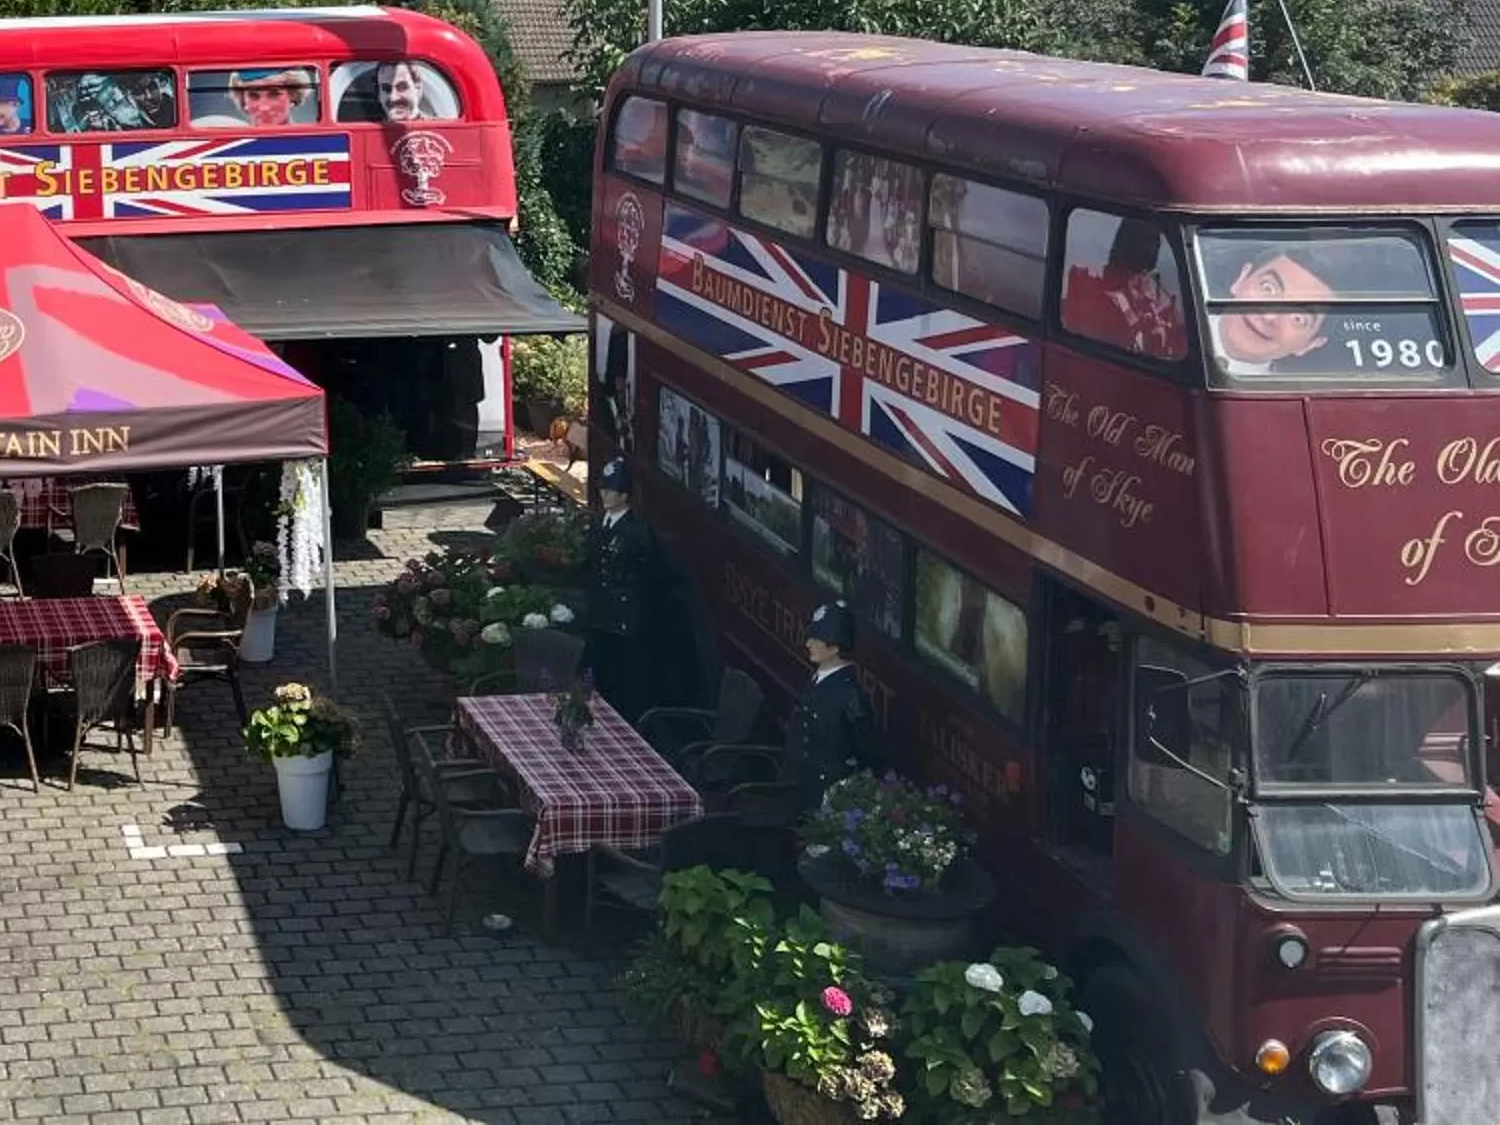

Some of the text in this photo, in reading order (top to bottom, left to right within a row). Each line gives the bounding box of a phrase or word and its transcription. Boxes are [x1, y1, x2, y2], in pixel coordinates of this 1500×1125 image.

[36, 159, 329, 195] SIEBENGEBIRGE
[691, 252, 1003, 435] BAUMDIENST SIEBENGEBIRGE
[1343, 321, 1381, 332] since
[1346, 339, 1444, 368] 1980
[70, 426, 130, 456] INN
[1045, 380, 1195, 476] The Old Man
[1321, 438, 1416, 488] The
[1062, 456, 1153, 529] of Skye
[1401, 512, 1462, 586] of
